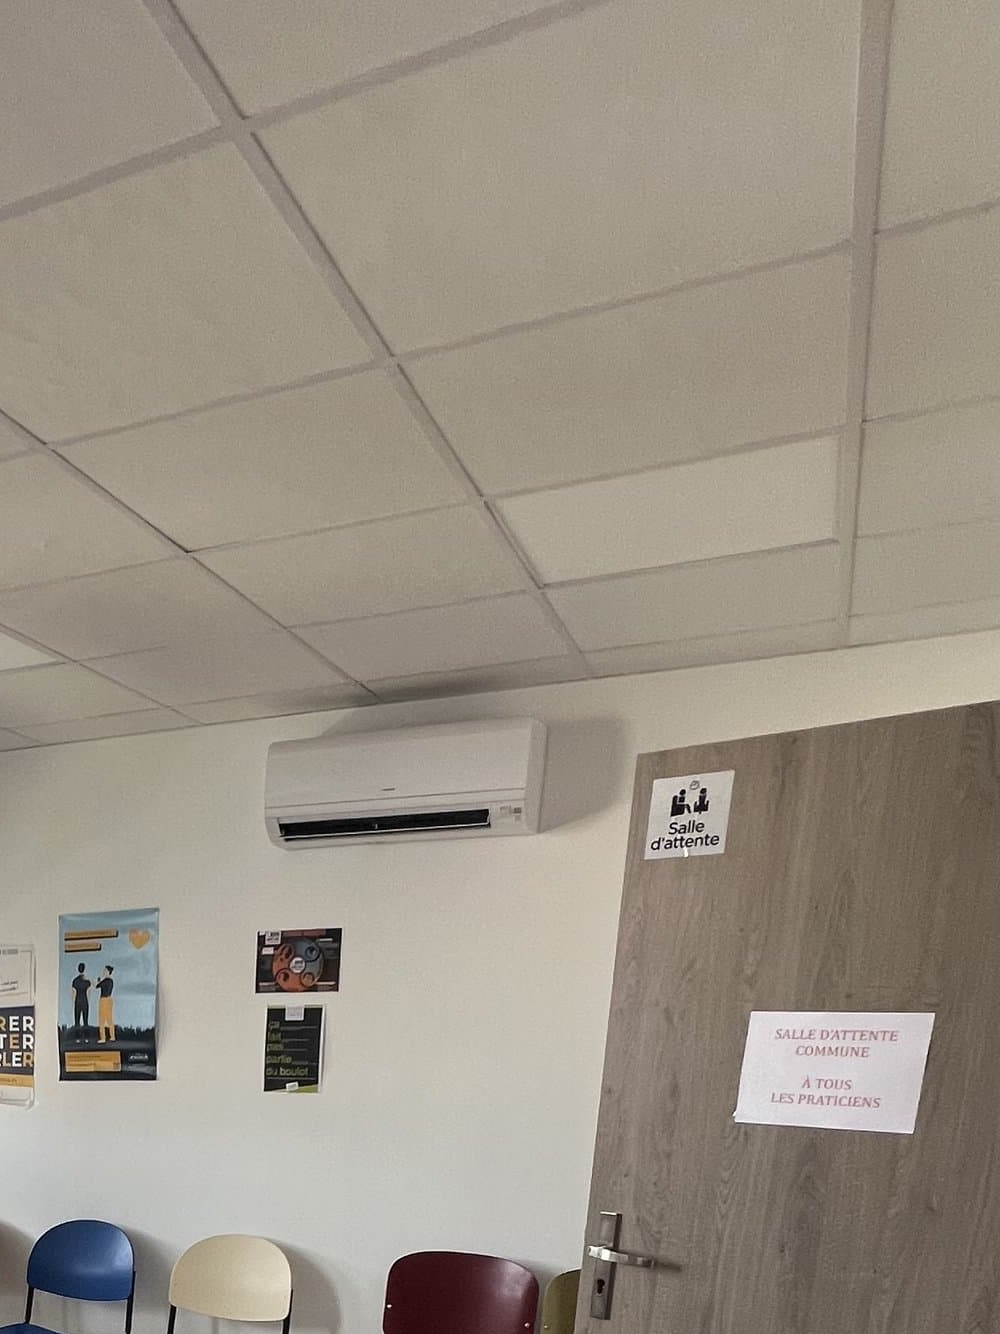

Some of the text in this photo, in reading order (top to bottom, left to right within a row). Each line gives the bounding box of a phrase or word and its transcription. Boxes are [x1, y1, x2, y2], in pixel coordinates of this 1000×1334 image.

[668, 820, 705, 835] Salle
[650, 834, 720, 851] d'attente
[775, 1028, 899, 1042] SALLE D'ATTENTE
[795, 1045, 870, 1058] COMMUNE
[816, 1078, 852, 1090] TOUS
[771, 1092, 881, 1109] LES PRATICIENS
